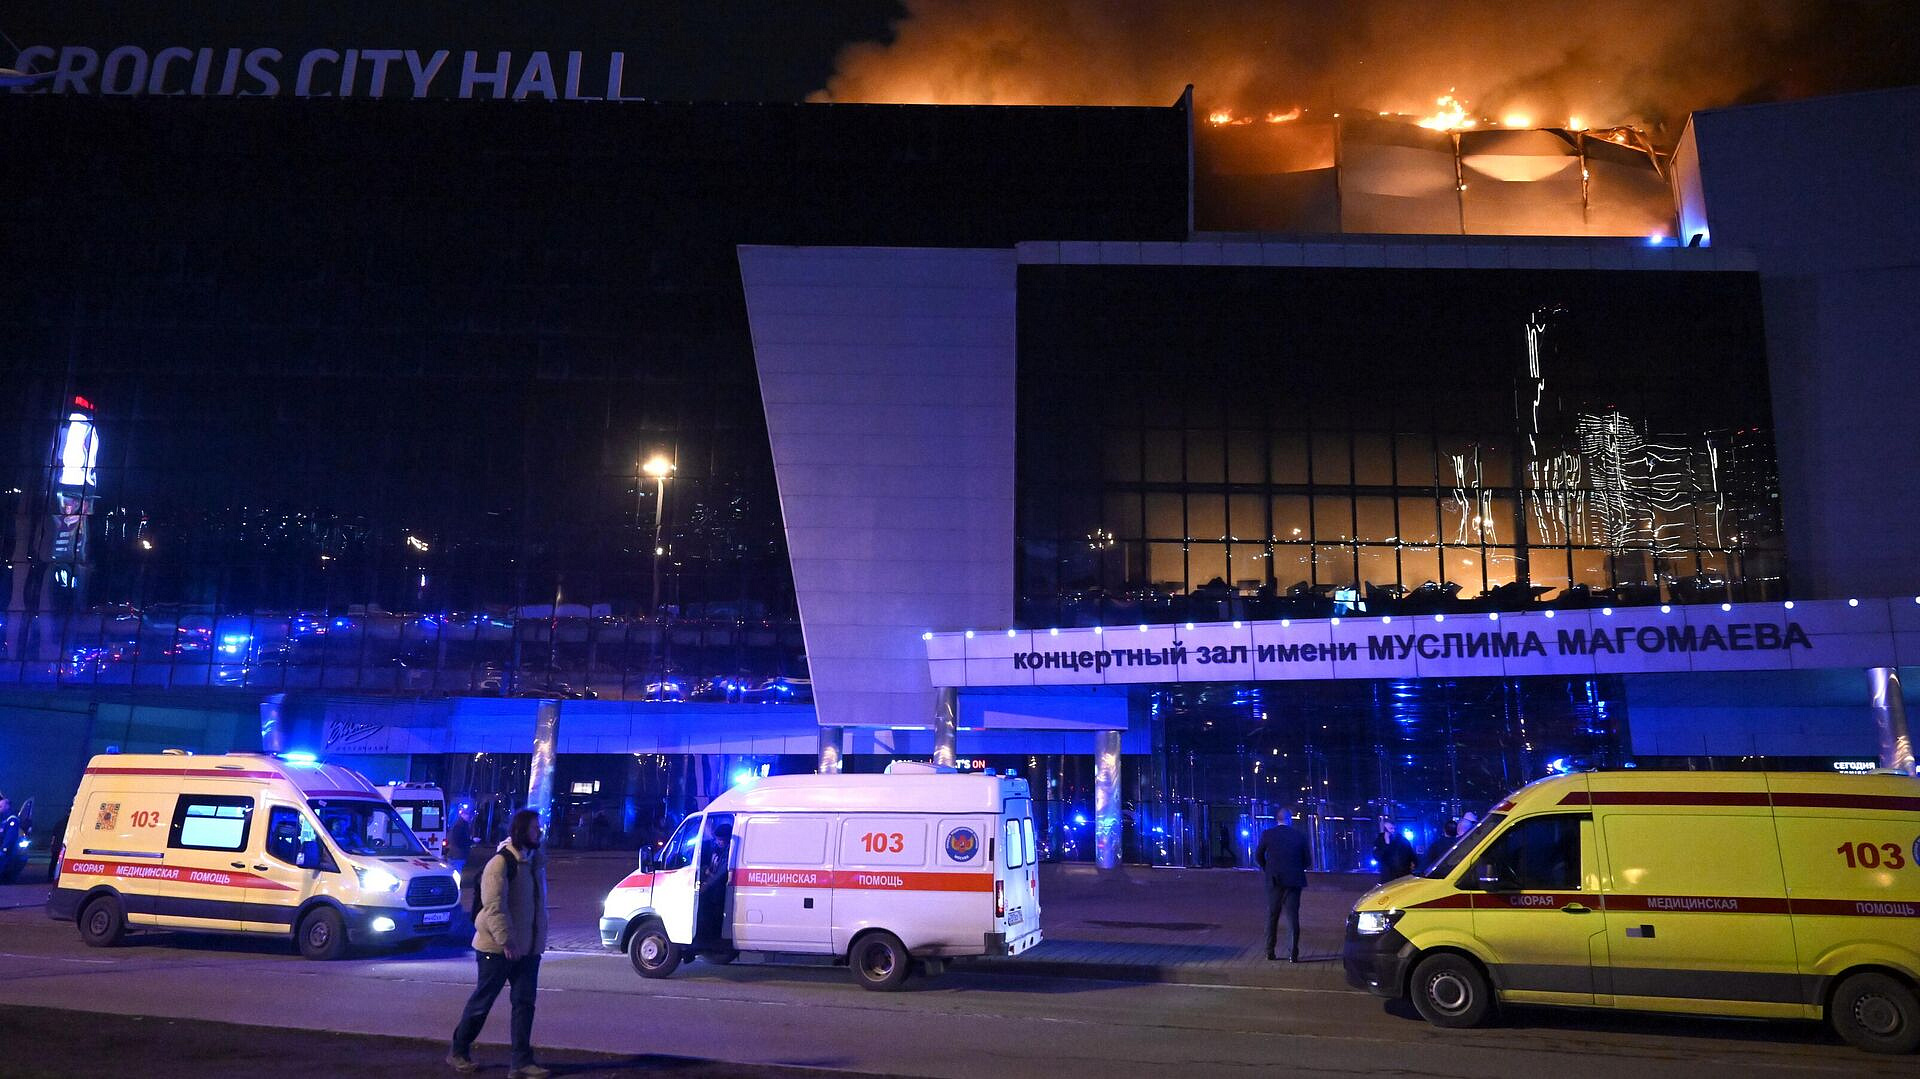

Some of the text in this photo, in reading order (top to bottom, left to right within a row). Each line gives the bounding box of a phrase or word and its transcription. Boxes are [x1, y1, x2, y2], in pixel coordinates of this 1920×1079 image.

[10, 45, 645, 100] CROCUS CITY HALL
[1014, 622, 1813, 672] концертный зал имени МУСЛИМА МАГОМАЕВА
[972, 760, 985, 769] ON
[1833, 761, 1876, 770] СЕГОДНЯ
[131, 811, 160, 828] 103
[861, 832, 904, 853] 103
[1837, 842, 1905, 869] 103
[72, 863, 231, 885] СКОРАЯ МЕДИЦИНСКАЯ ПОМОЩЬ
[748, 872, 903, 887] МЕДИЦИНСКАЯ ПОМОЩЬ
[1510, 896, 1915, 916] СКОРАЯ МЕДИЦИНСКАЯ ПОМОЩЬ
